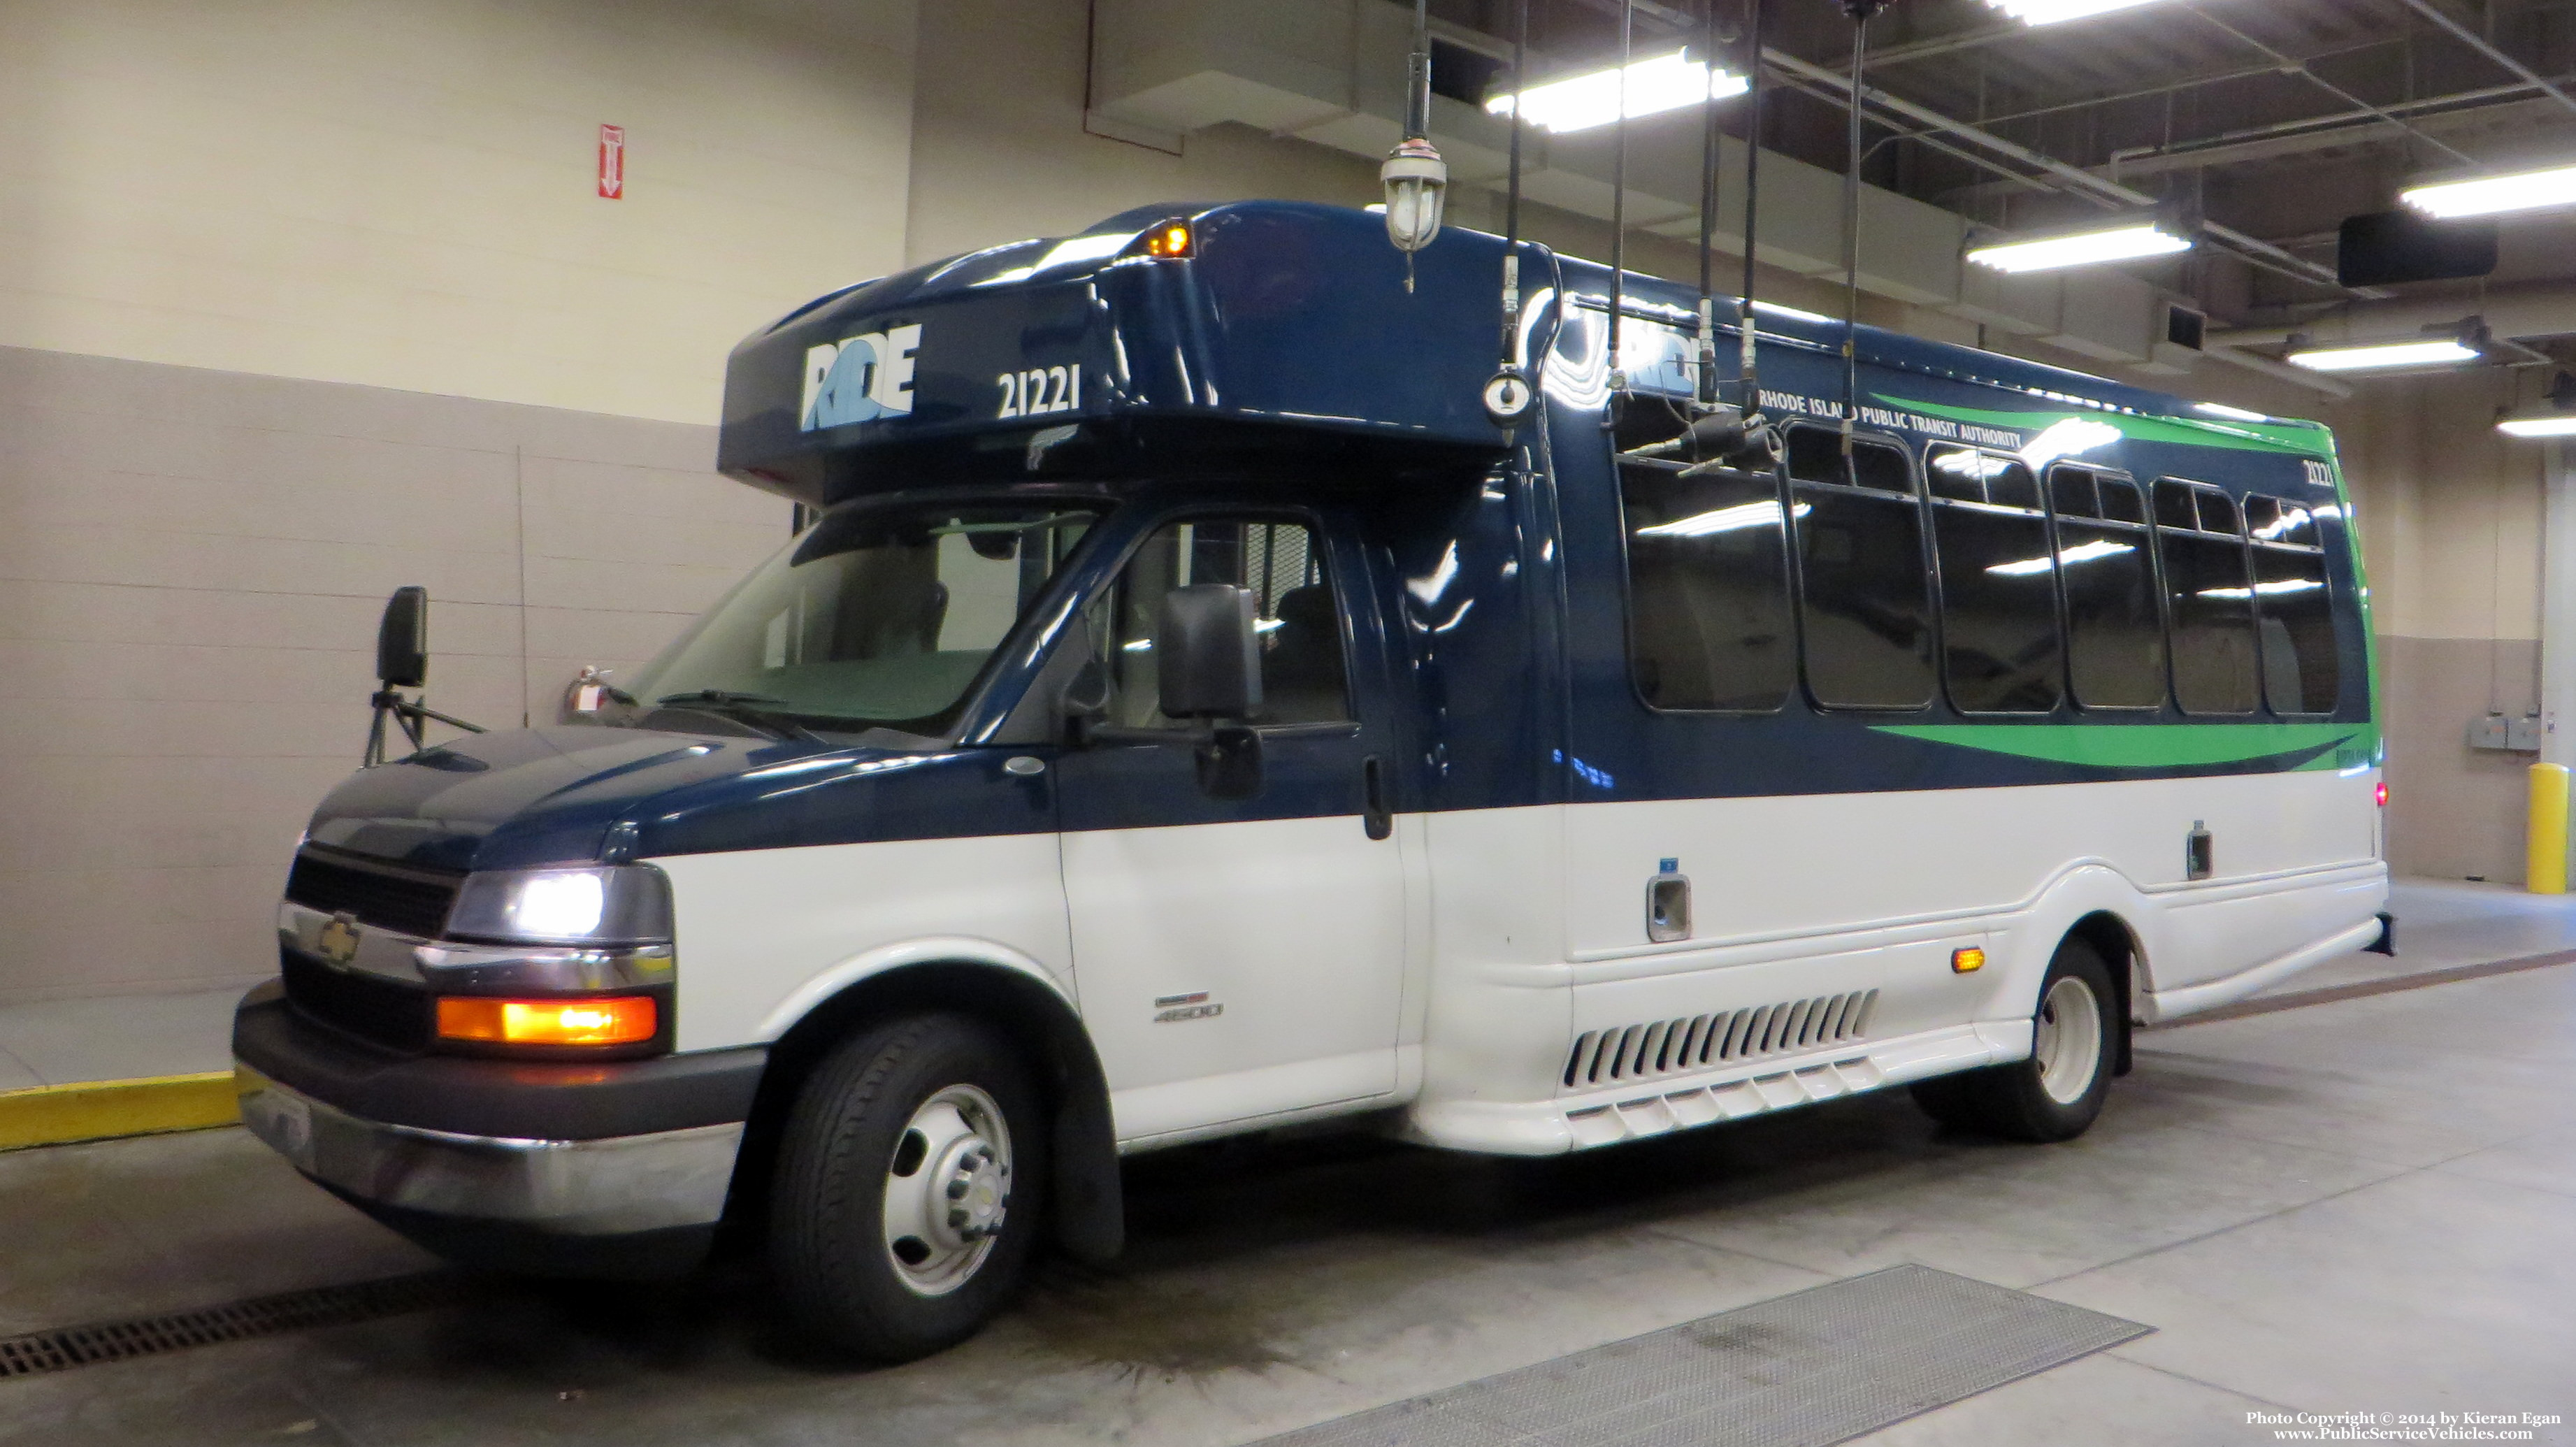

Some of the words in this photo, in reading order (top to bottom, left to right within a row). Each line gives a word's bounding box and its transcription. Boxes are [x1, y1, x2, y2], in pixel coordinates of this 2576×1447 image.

[801, 324, 922, 432] RIDE
[998, 363, 1080, 419] 21221
[1759, 389, 1808, 413] RHODE
[1862, 407, 1909, 429] PUBLIC
[1909, 415, 1958, 438] TRANSIT
[1960, 424, 2022, 449] AUTHORITY
[2303, 459, 2335, 487] 21221
